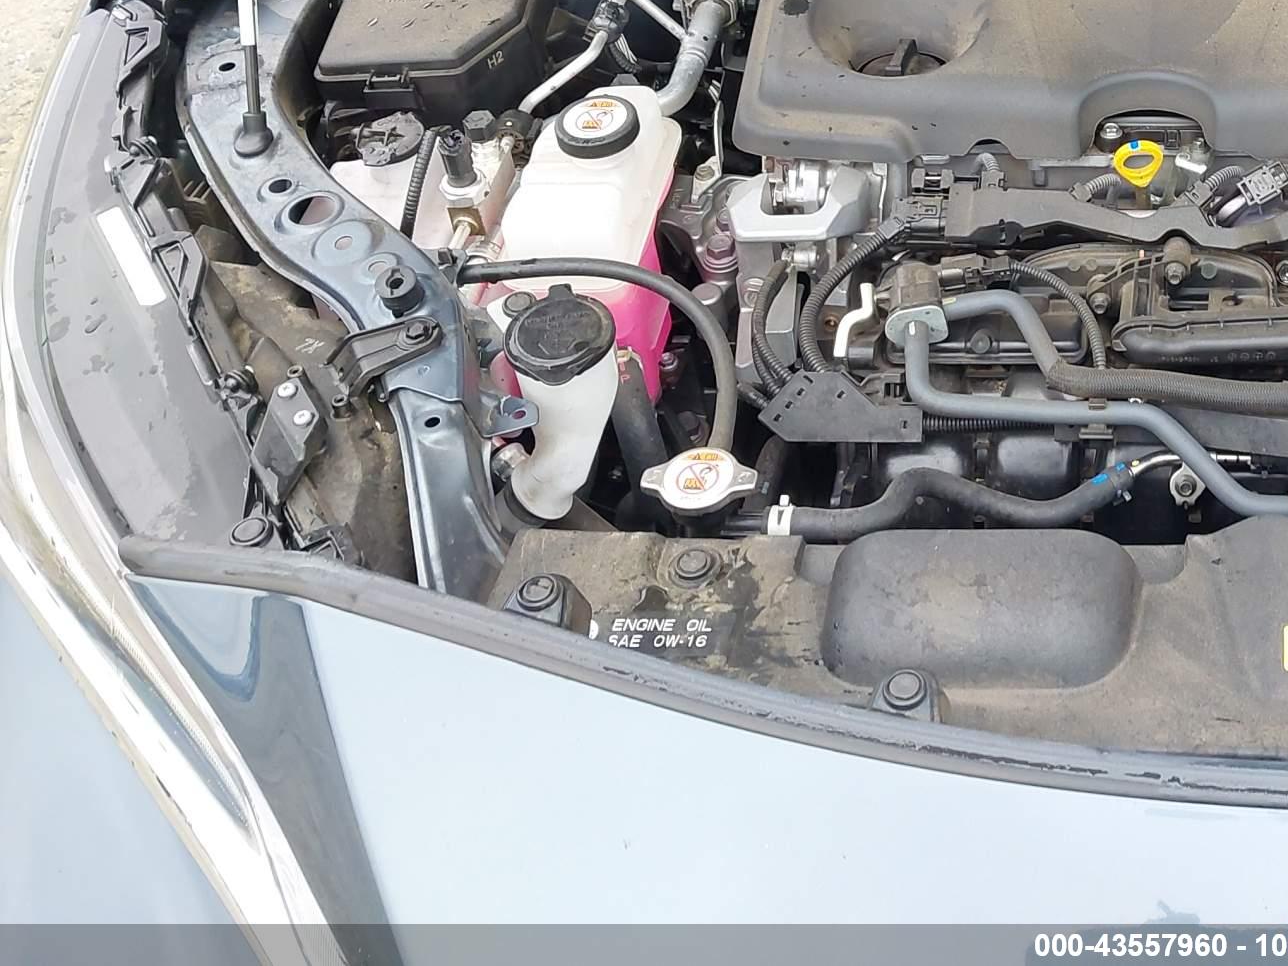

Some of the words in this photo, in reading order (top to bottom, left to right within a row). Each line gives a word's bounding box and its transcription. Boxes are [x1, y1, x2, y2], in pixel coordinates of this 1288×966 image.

[487, 50, 504, 69] H2
[612, 618, 676, 632] ENGINE
[686, 619, 712, 632] OIL
[608, 635, 643, 648] SAE
